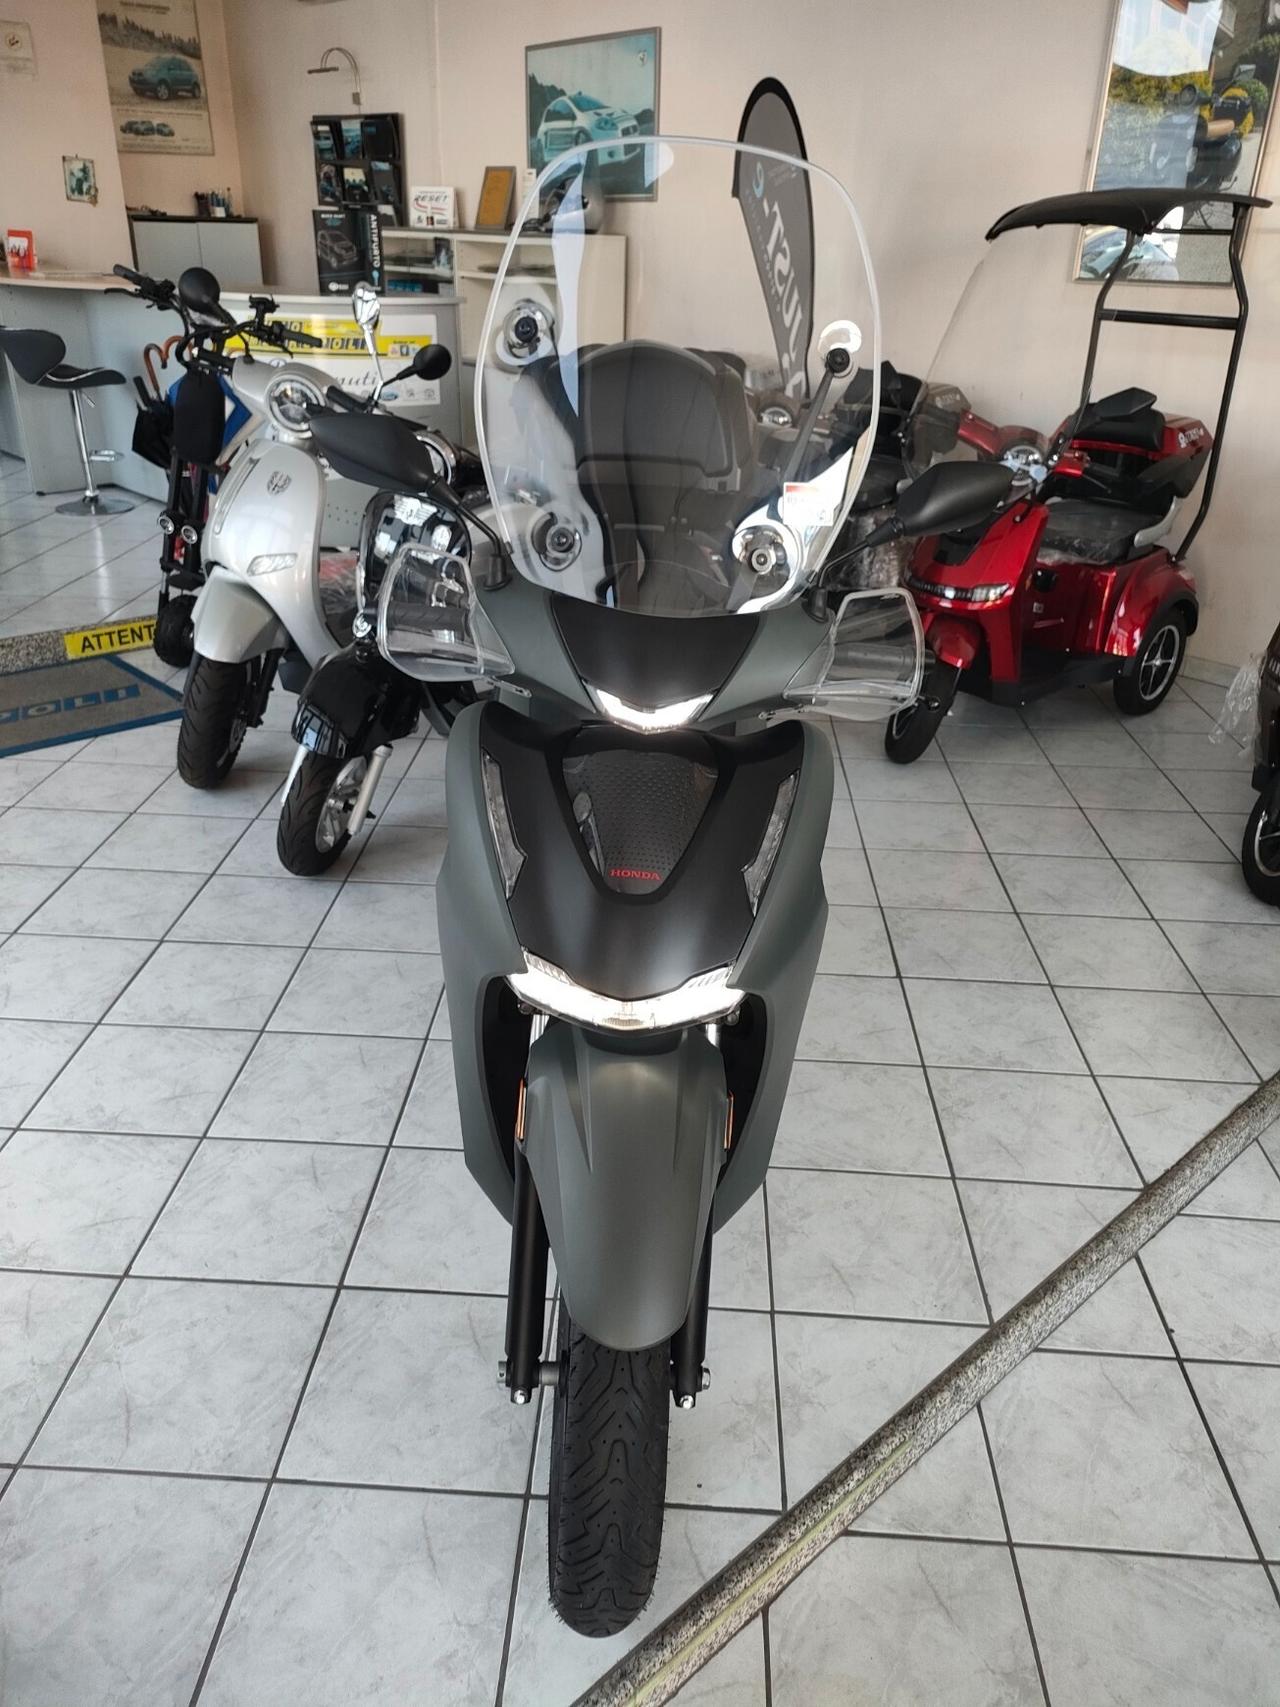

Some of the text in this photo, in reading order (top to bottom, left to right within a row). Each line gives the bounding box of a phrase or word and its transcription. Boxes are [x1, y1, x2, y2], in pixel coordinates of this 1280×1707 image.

[370, 214, 381, 268] ANTIFURTO
[81, 624, 155, 653] ATTENT
[609, 868, 661, 881] HONDA
